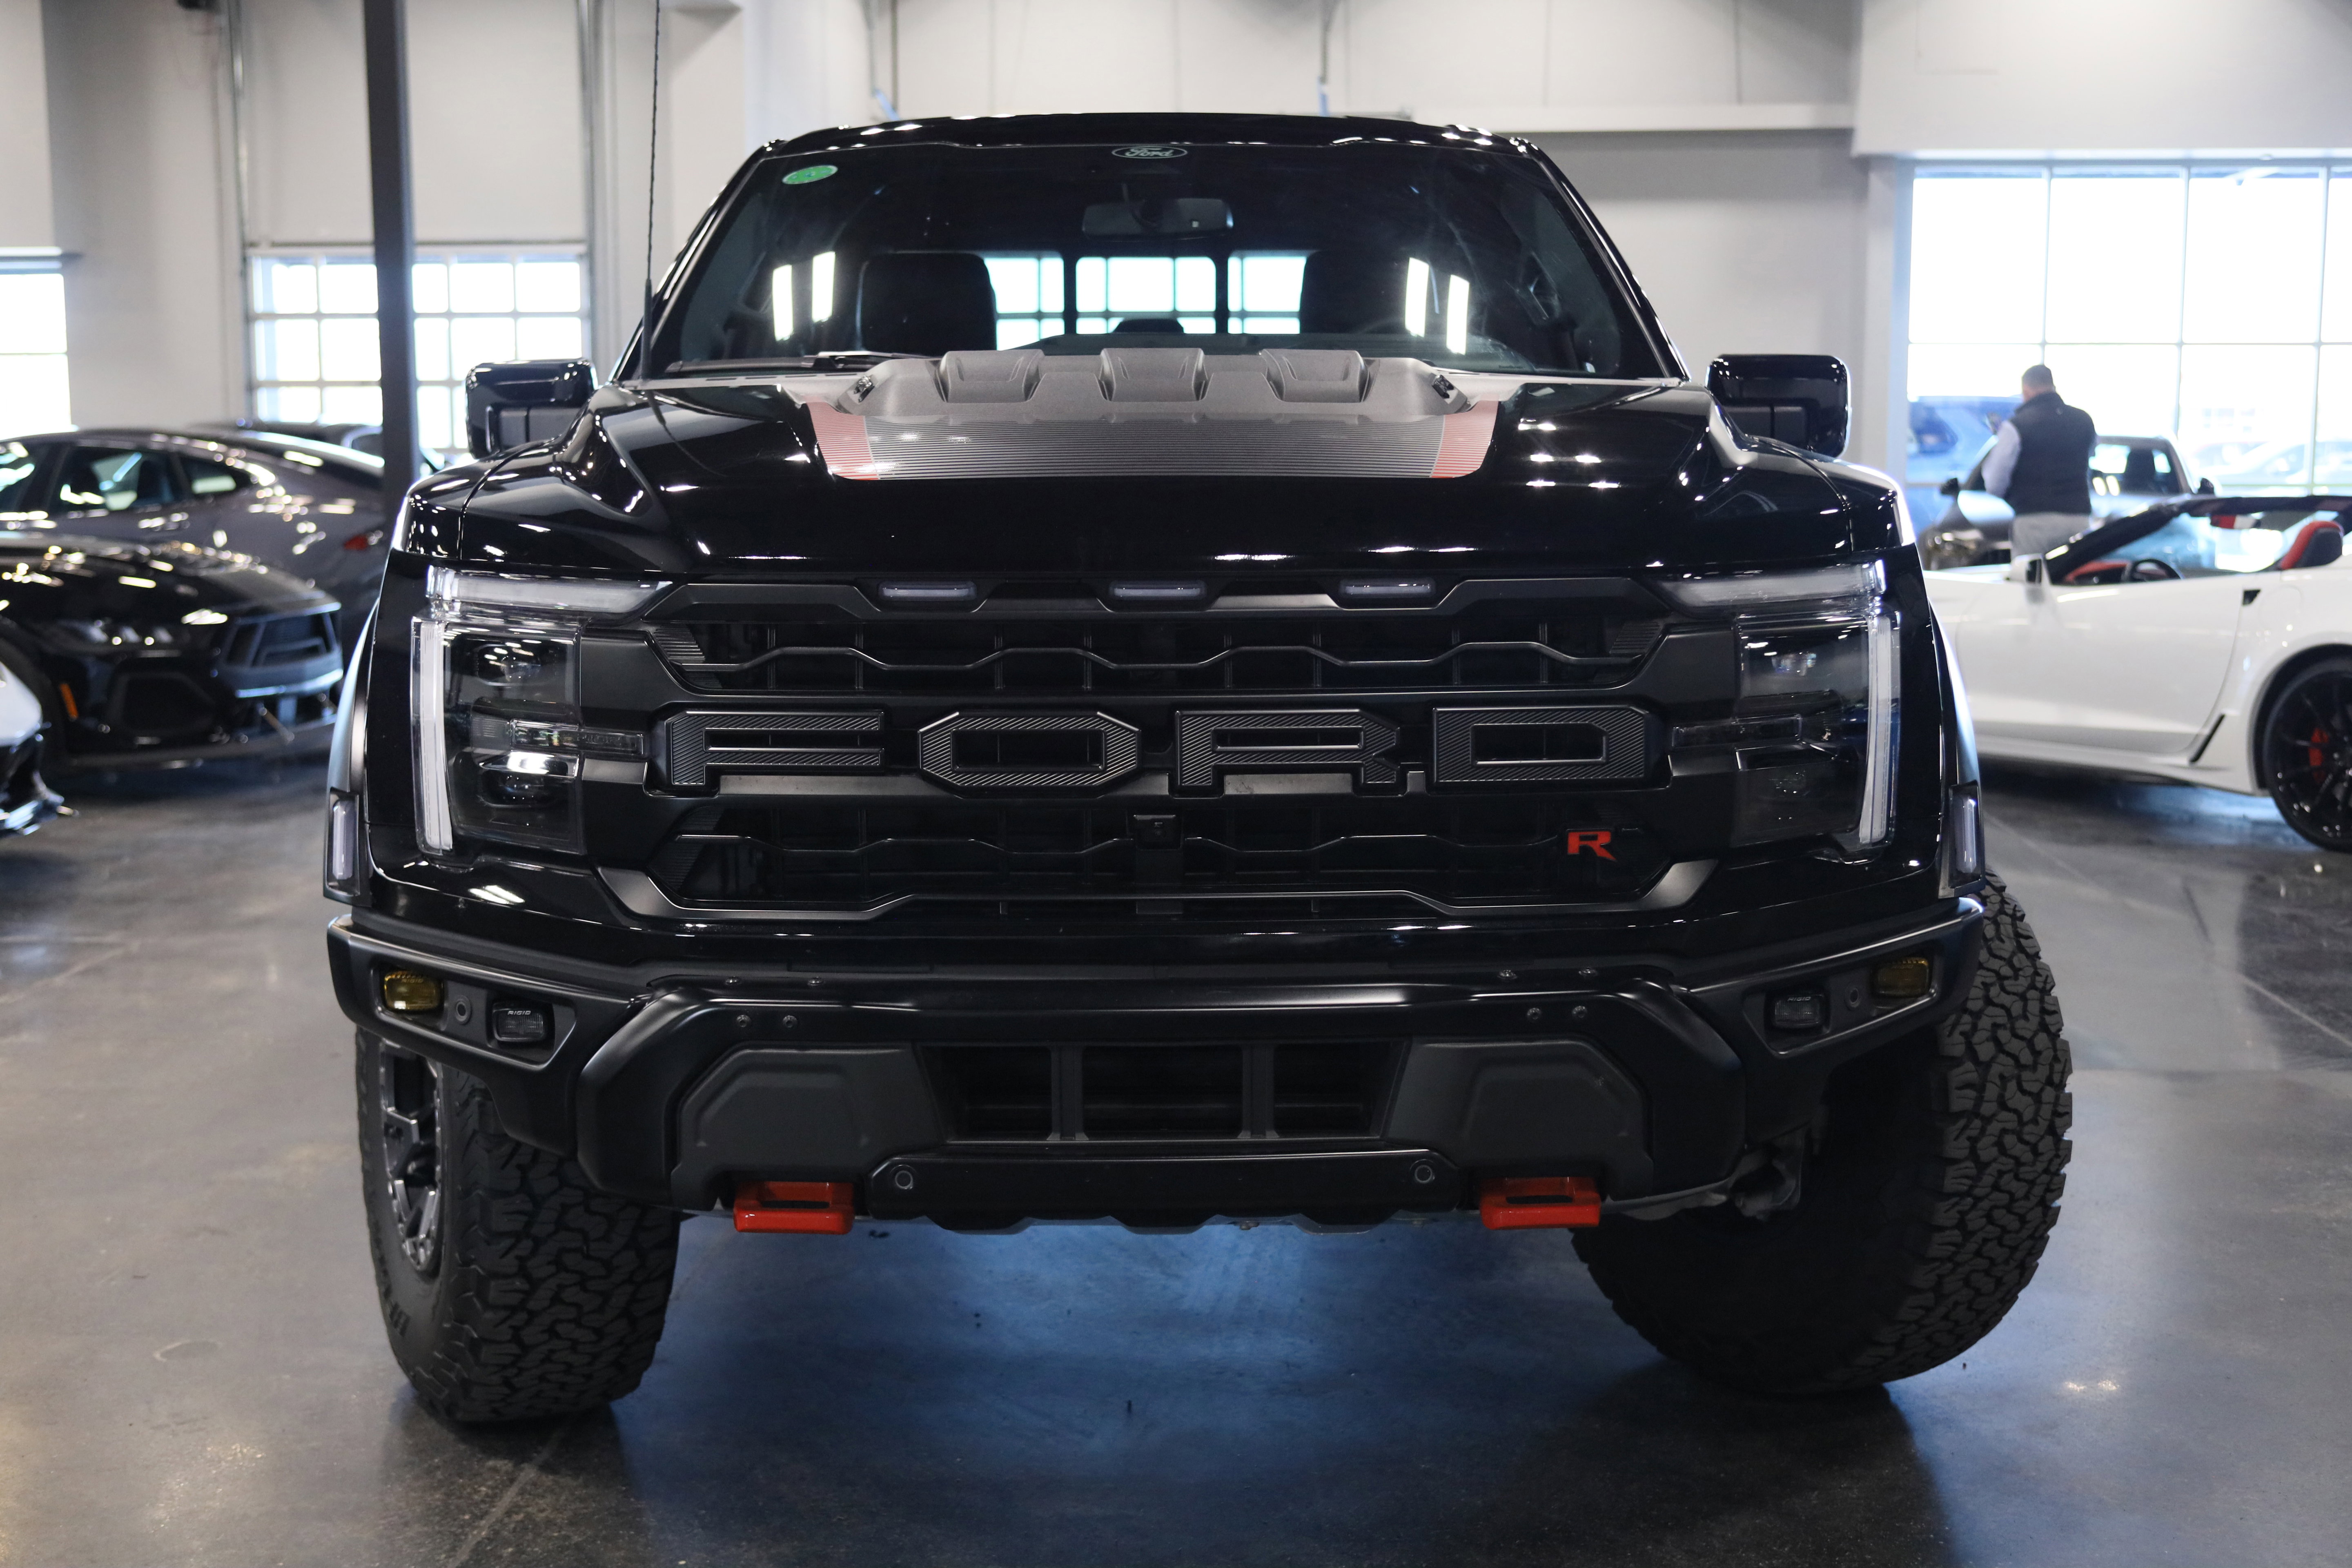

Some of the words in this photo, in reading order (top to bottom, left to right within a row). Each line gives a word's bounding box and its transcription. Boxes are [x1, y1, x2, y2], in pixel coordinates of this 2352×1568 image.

[1125, 148, 1174, 156] Ford
[667, 706, 1648, 788] FORD
[1567, 830, 1617, 862] R
